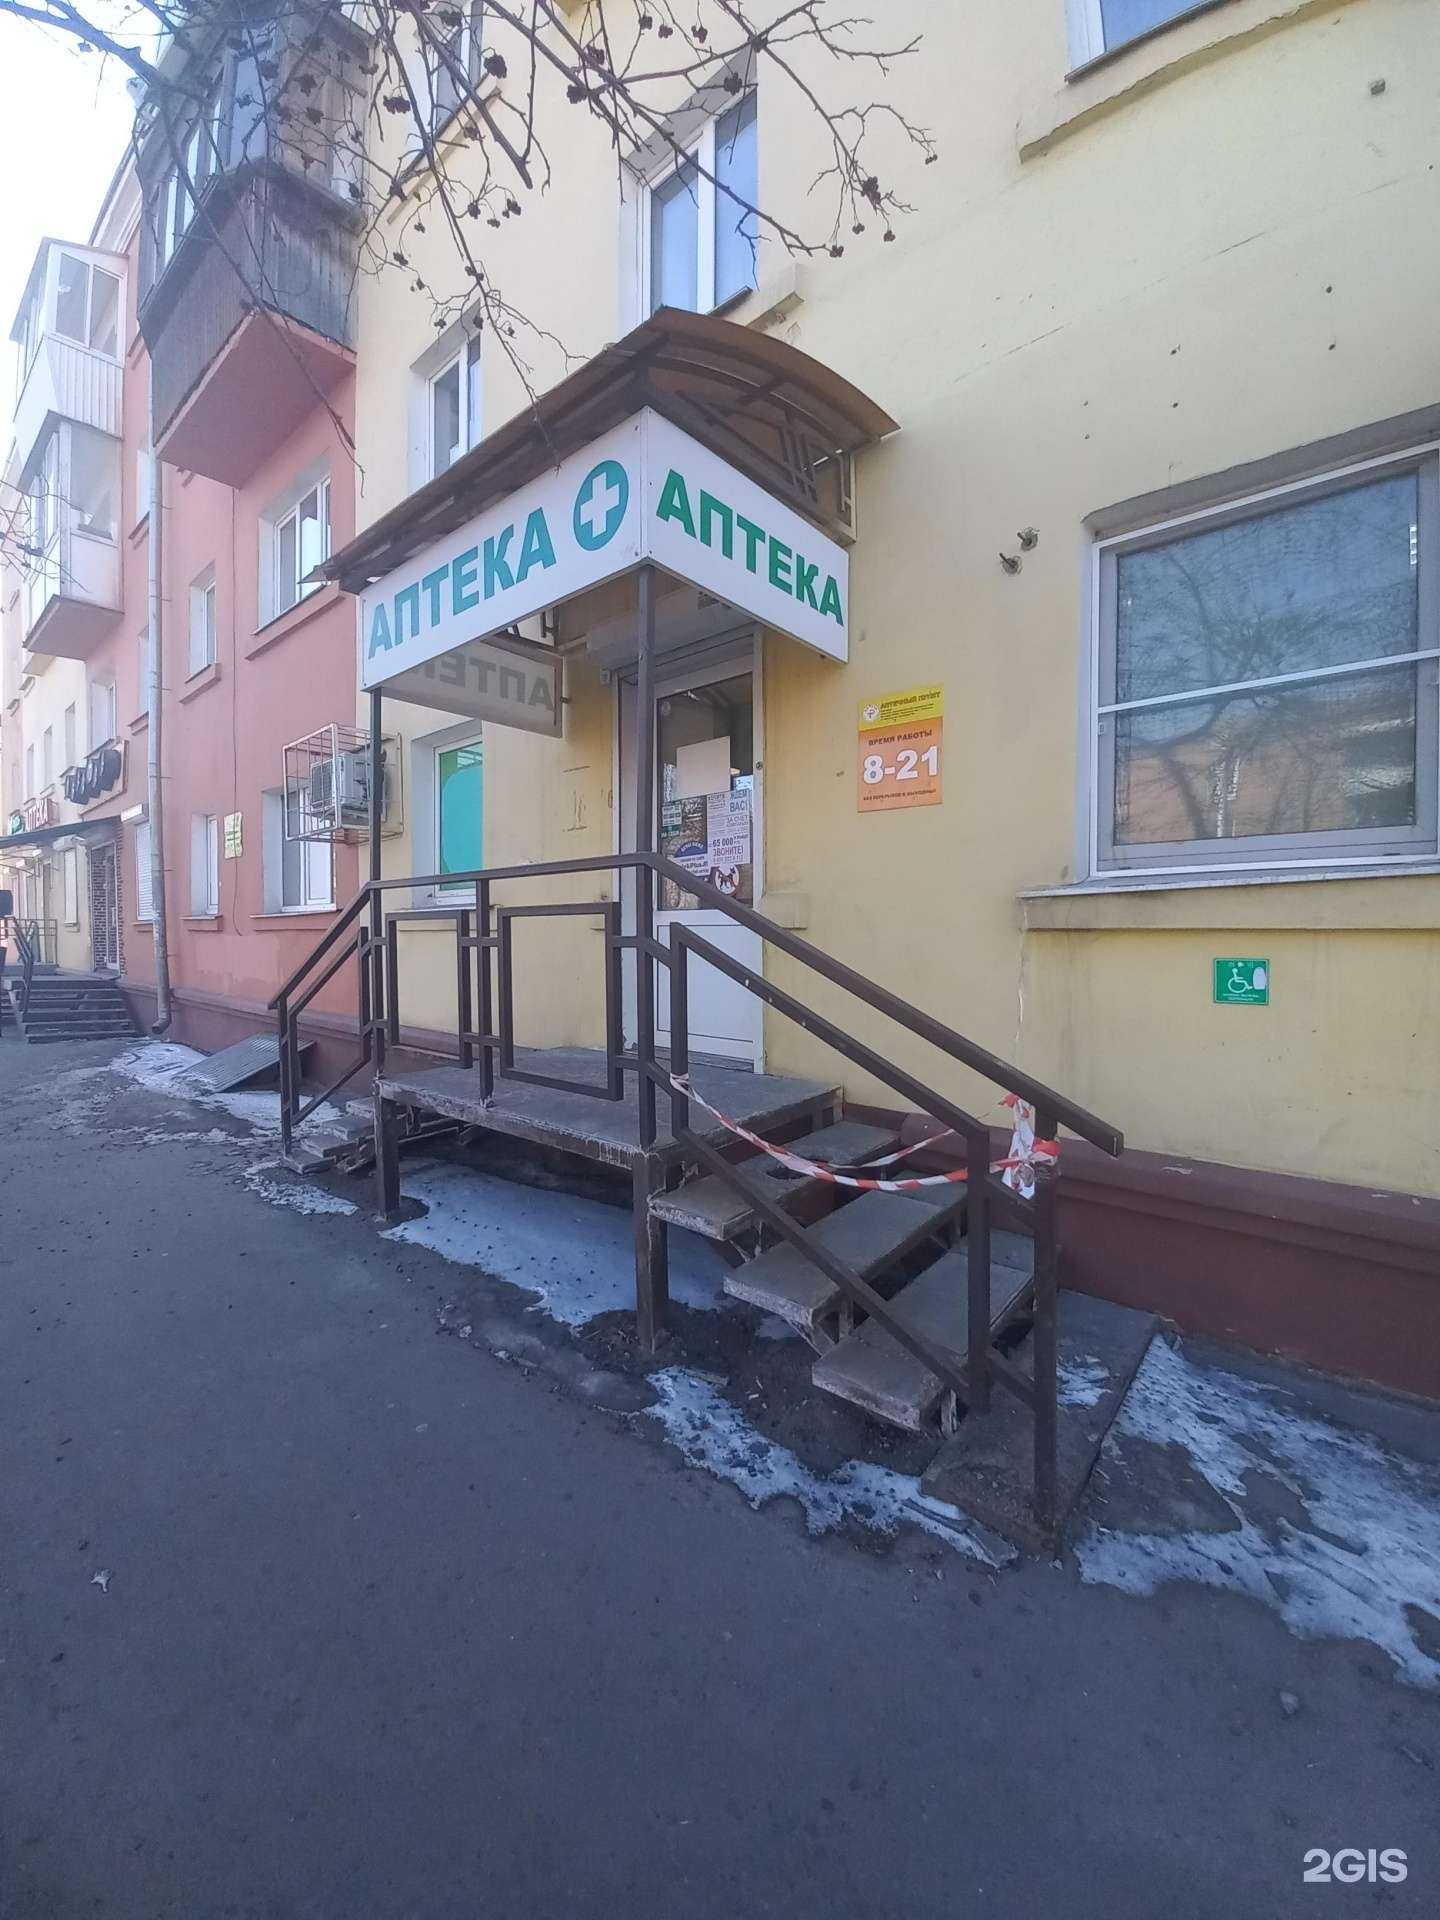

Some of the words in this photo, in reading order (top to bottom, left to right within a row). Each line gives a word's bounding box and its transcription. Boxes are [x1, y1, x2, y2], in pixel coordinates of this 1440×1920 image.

[367, 506, 557, 660] АПТЕКА
[656, 468, 845, 627] АПТЕКА
[863, 745, 939, 785] 8-21
[868, 736, 895, 746] ВРЕМЯ
[897, 729, 932, 741] РАБОТЫ
